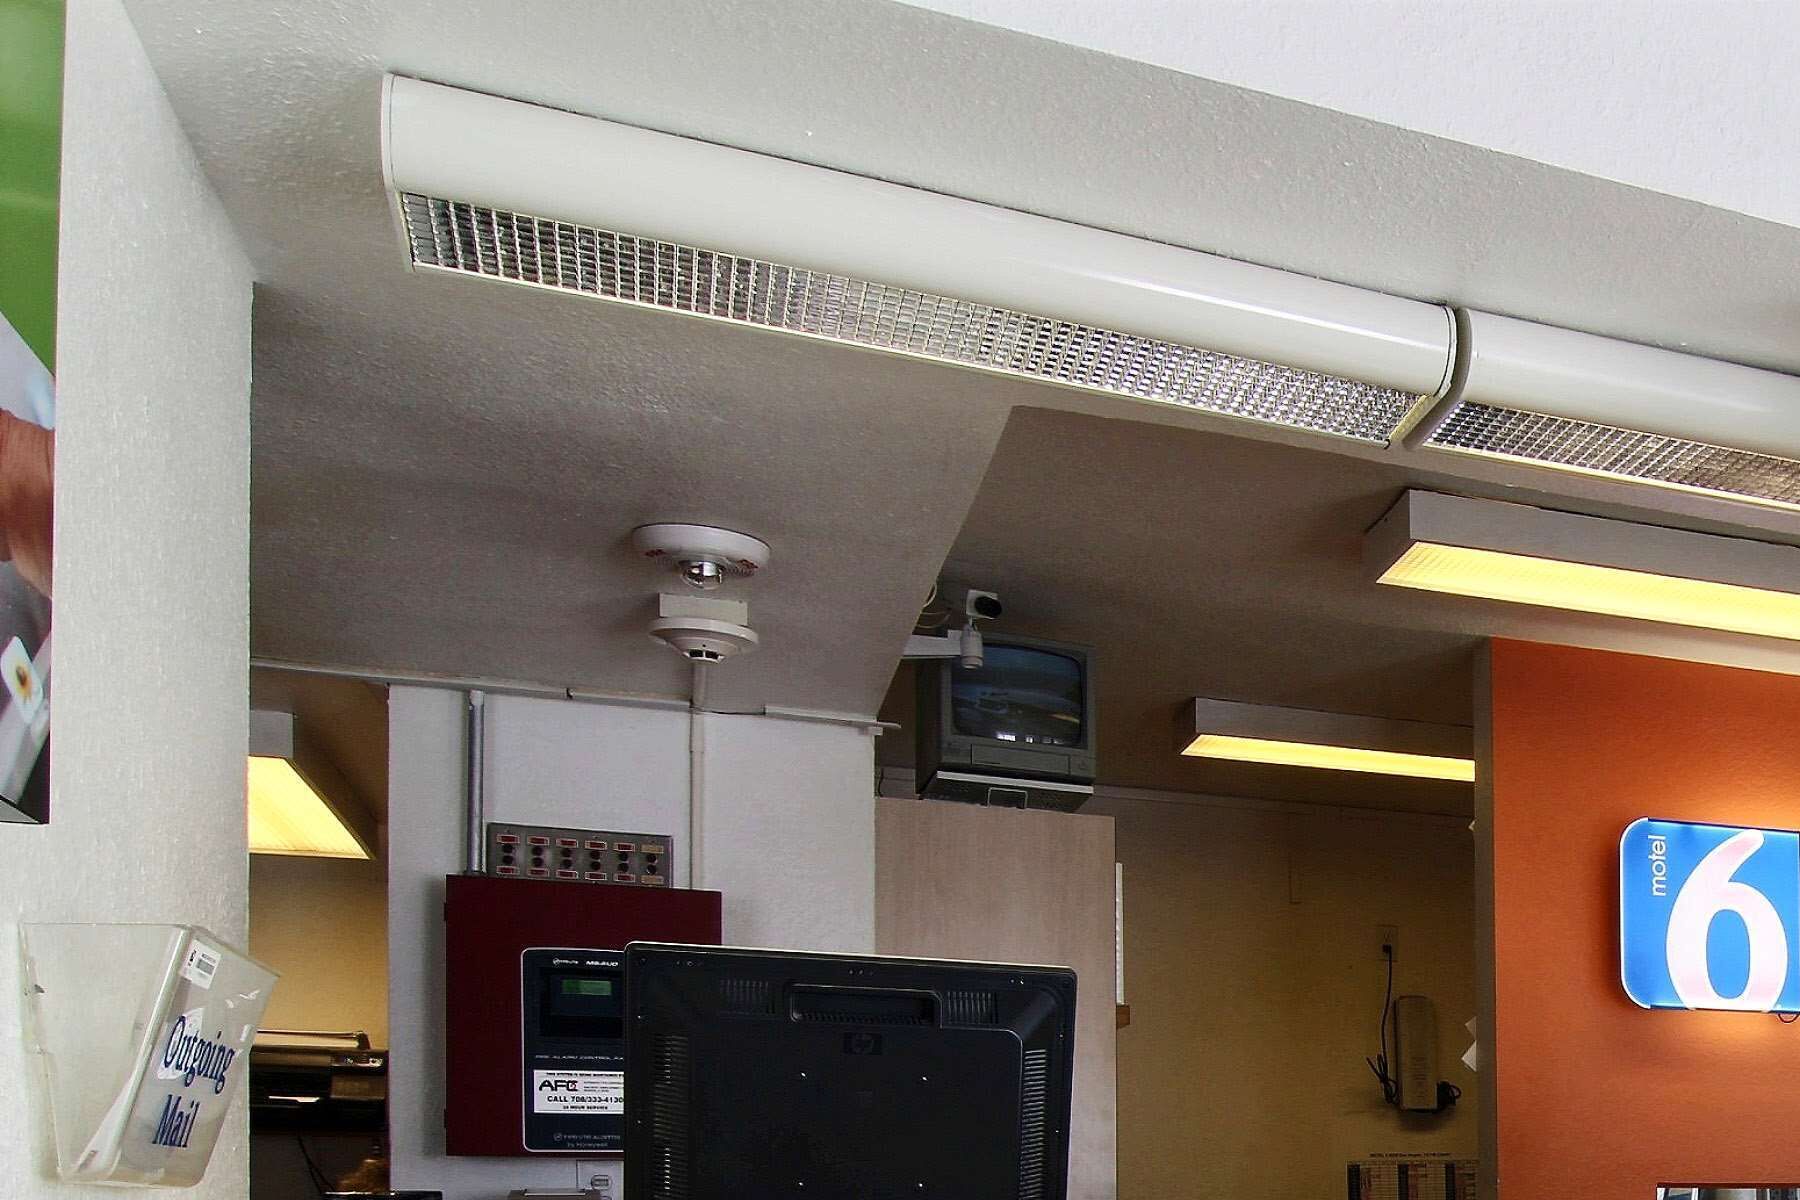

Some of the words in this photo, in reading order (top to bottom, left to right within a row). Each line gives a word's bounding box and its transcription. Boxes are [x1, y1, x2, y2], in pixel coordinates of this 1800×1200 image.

[1647, 834, 1667, 897] motel
[1665, 828, 1789, 1012] 6
[164, 1015, 236, 1094] Outgoing
[152, 1094, 200, 1148] Mail
[547, 1095, 569, 1103] CALL
